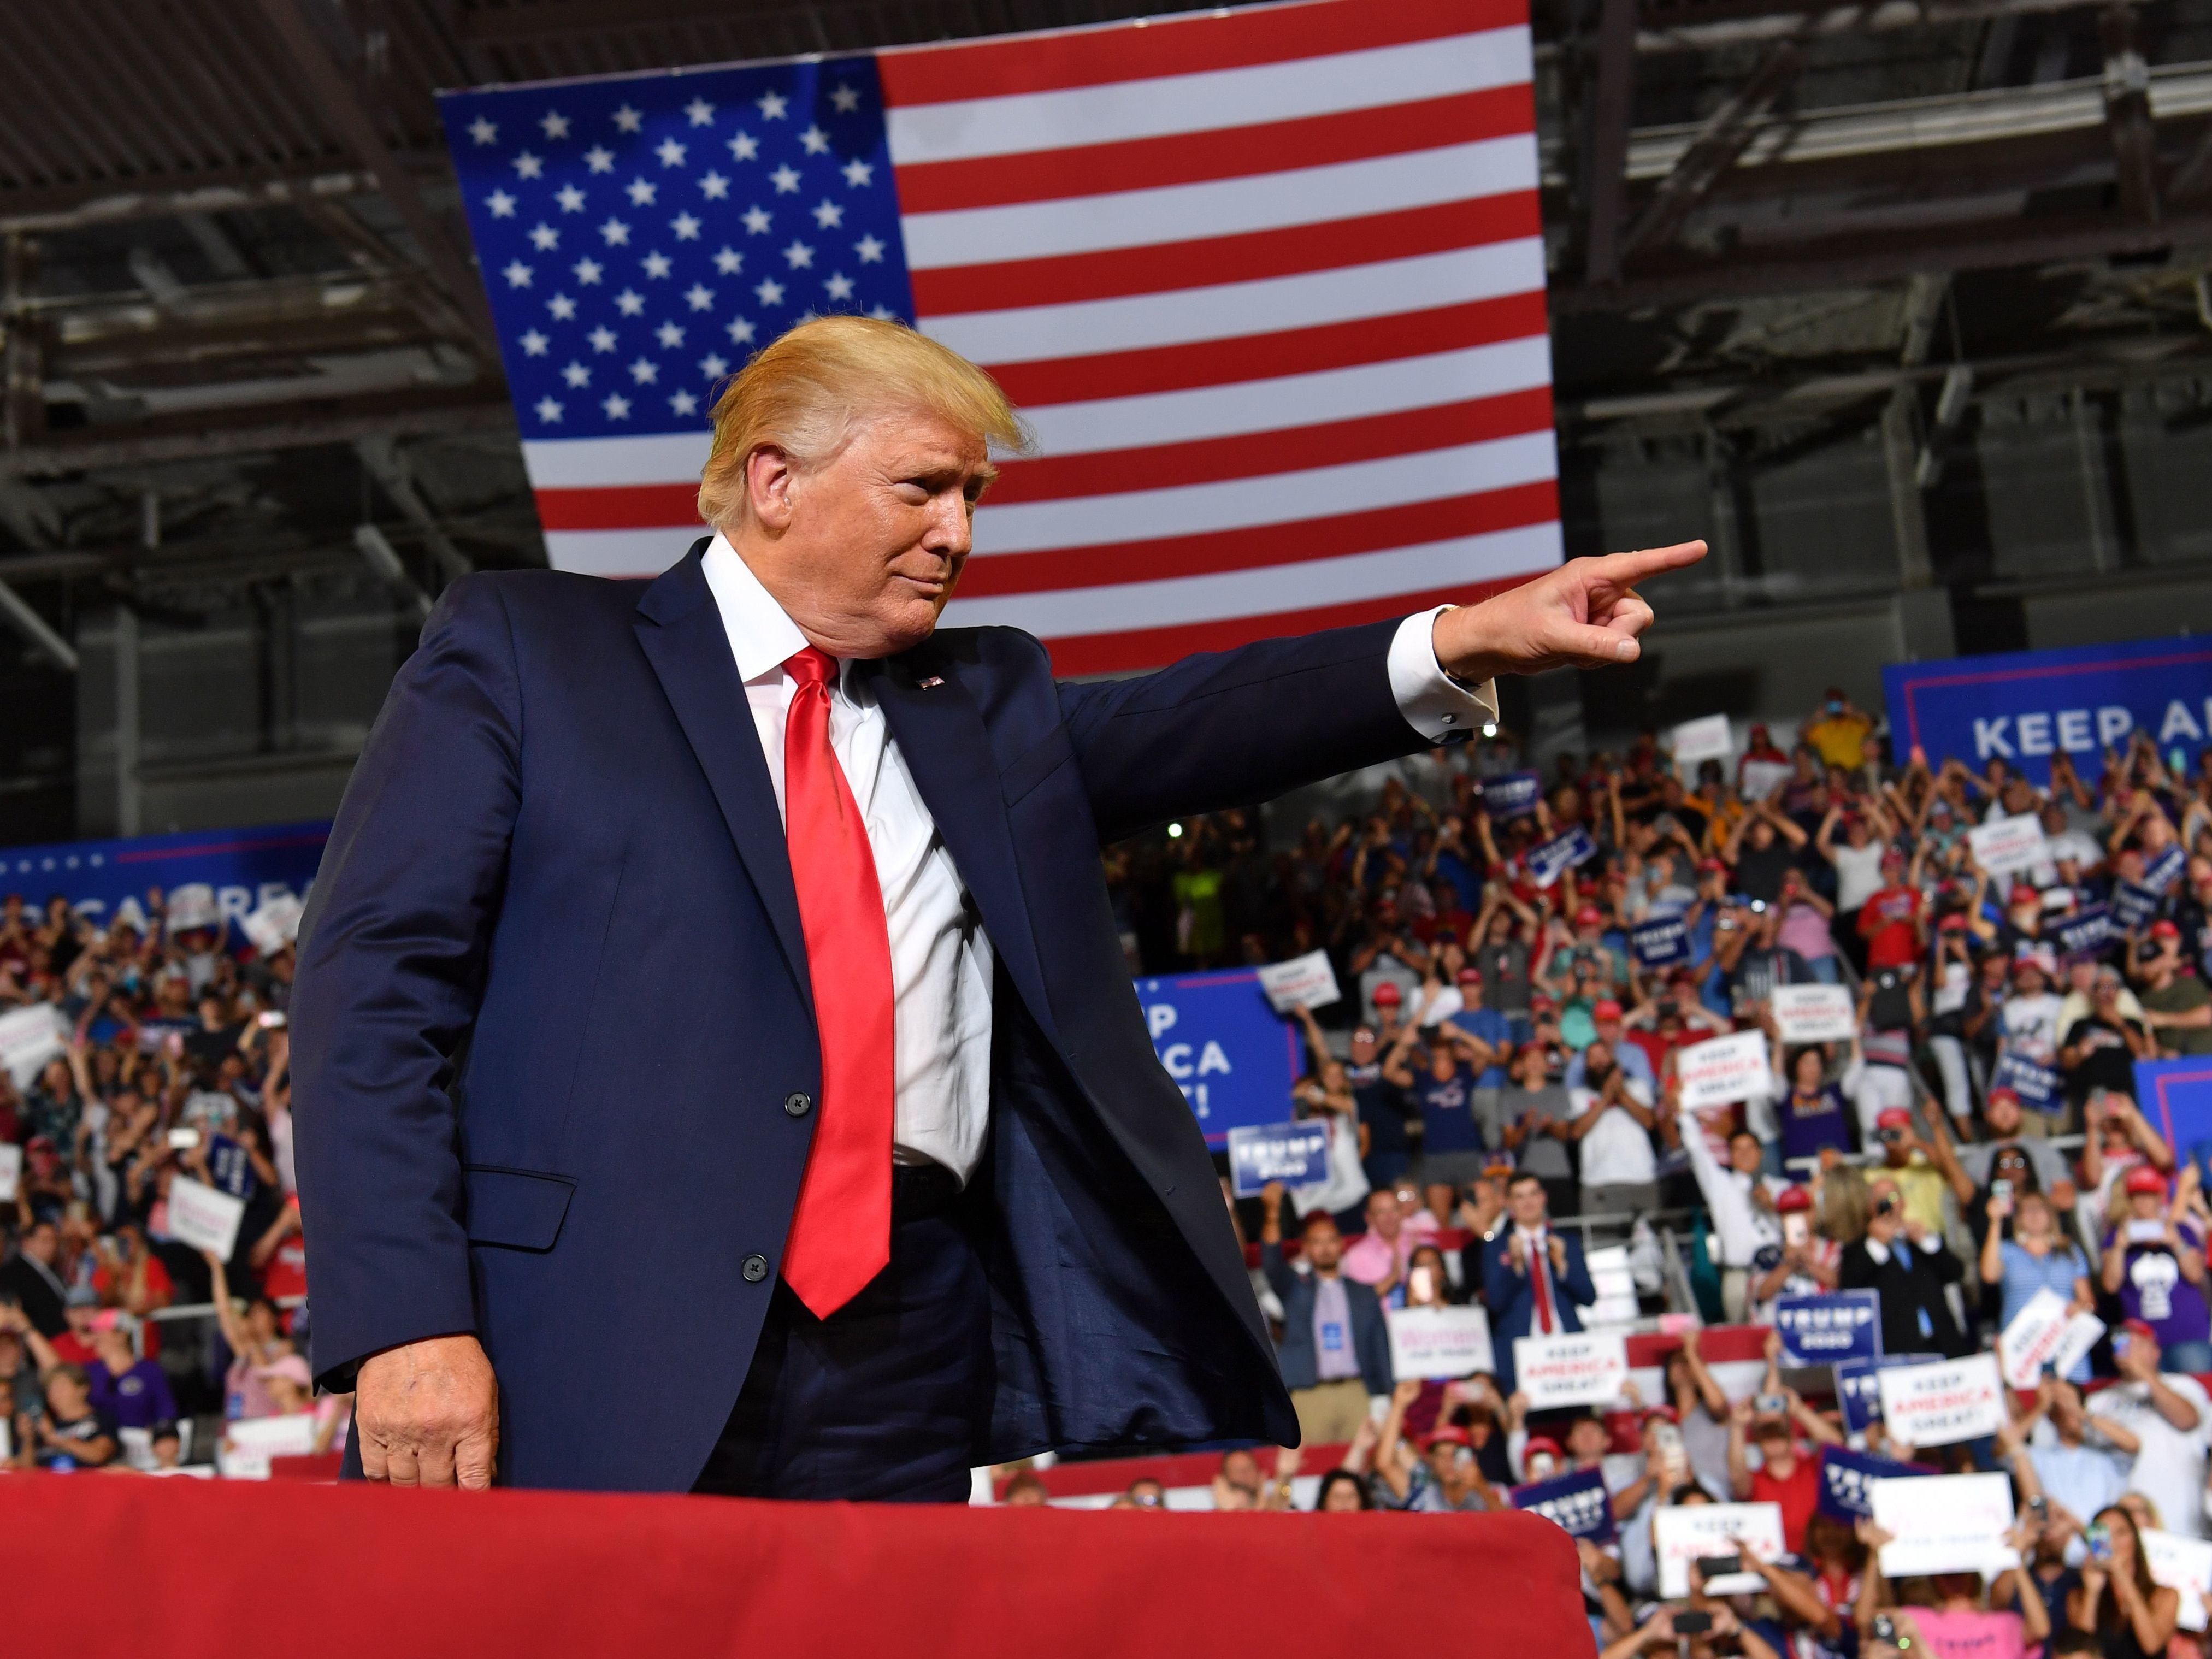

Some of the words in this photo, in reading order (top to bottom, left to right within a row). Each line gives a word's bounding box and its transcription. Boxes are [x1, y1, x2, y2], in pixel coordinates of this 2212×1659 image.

[1973, 705, 2133, 760] KEEP
[1237, 1135, 1324, 1162] TRUMP
[1779, 1304, 1873, 1330] TRUMP
[1546, 1344, 1592, 1359] KEEP
[1527, 1357, 1618, 1380] AMERICA
[1914, 1372, 1964, 1392] KEEP
[1893, 1385, 1994, 1415] AMERICA
